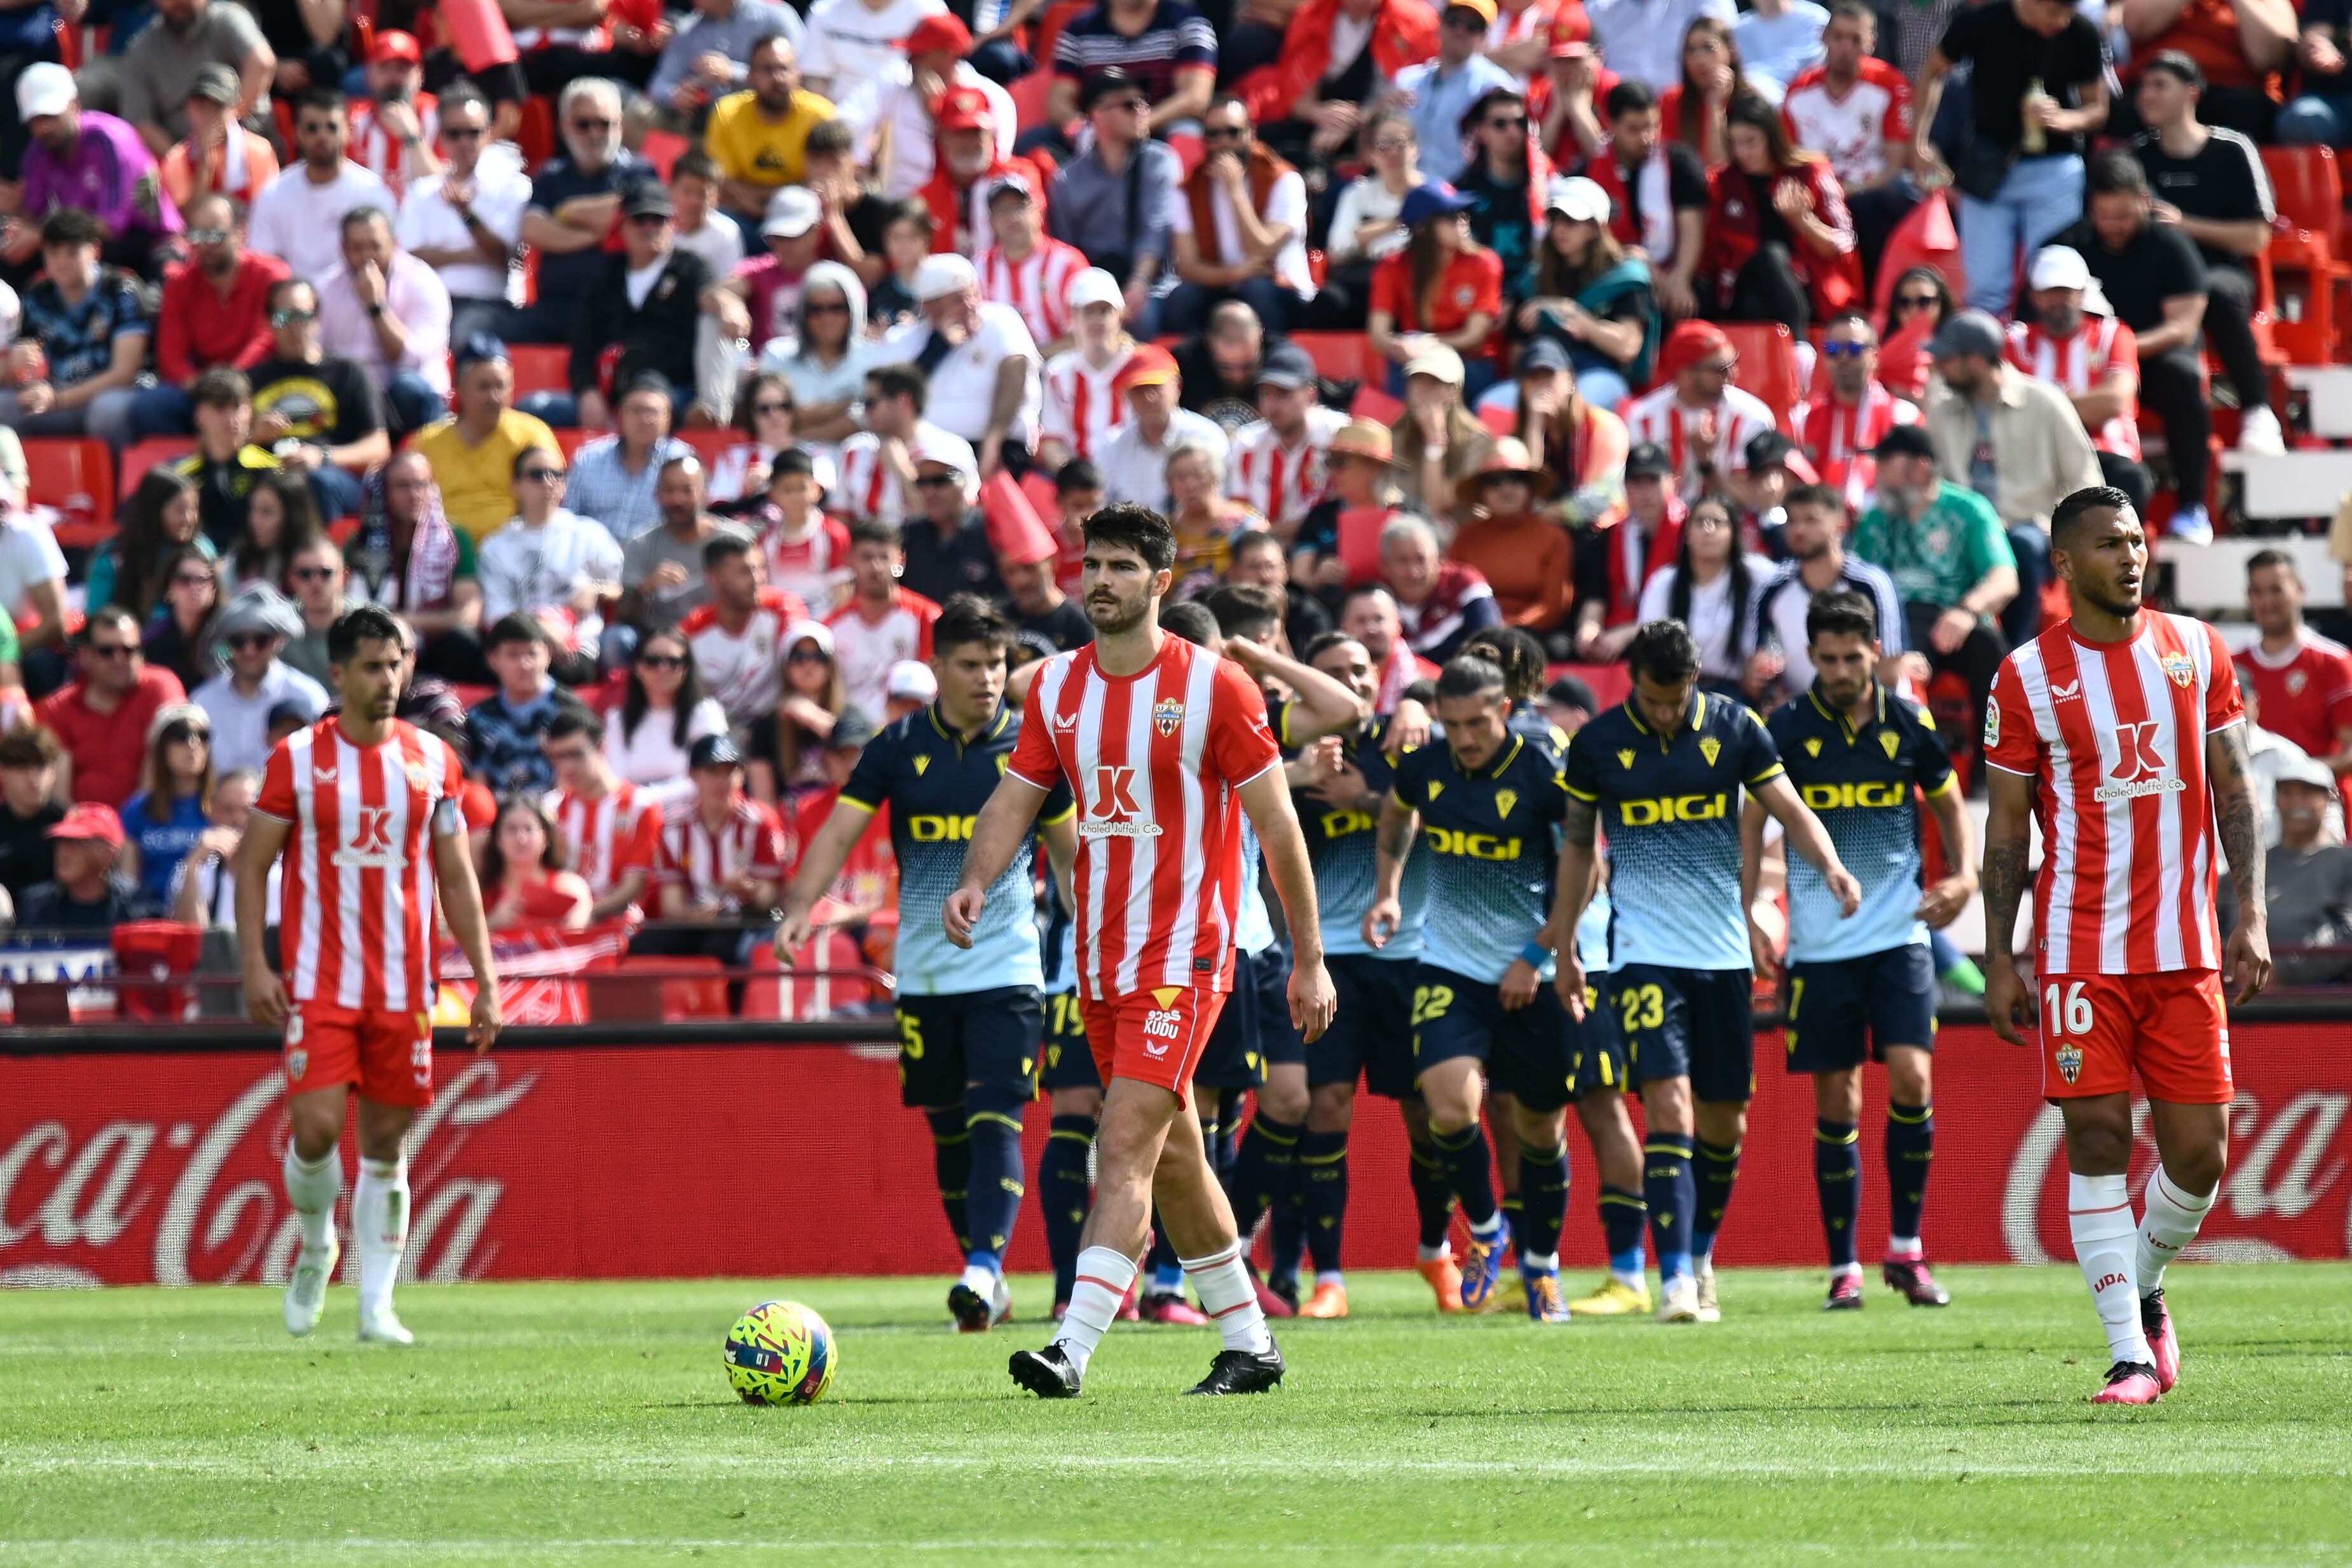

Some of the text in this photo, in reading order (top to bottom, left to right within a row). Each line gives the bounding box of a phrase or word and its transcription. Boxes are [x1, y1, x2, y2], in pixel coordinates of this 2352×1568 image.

[1984, 730, 1998, 741] aLiga
[2110, 723, 2166, 779] JK
[1091, 769, 1142, 817] JK
[1802, 781, 1905, 809] DIGI
[2097, 785, 2133, 800] Khaled
[2168, 779, 2184, 789] Co.
[1620, 794, 1726, 826] DIGI
[1081, 822, 1161, 835] Khaled Juffali Co.
[1426, 826, 1522, 861] DIGI
[1411, 986, 1454, 1025] 22
[1622, 983, 1664, 1032] 23
[2046, 981, 2093, 1036] 16
[1143, 1019, 1179, 1039] KUDU
[2094, 1272, 2128, 1293] UDA
